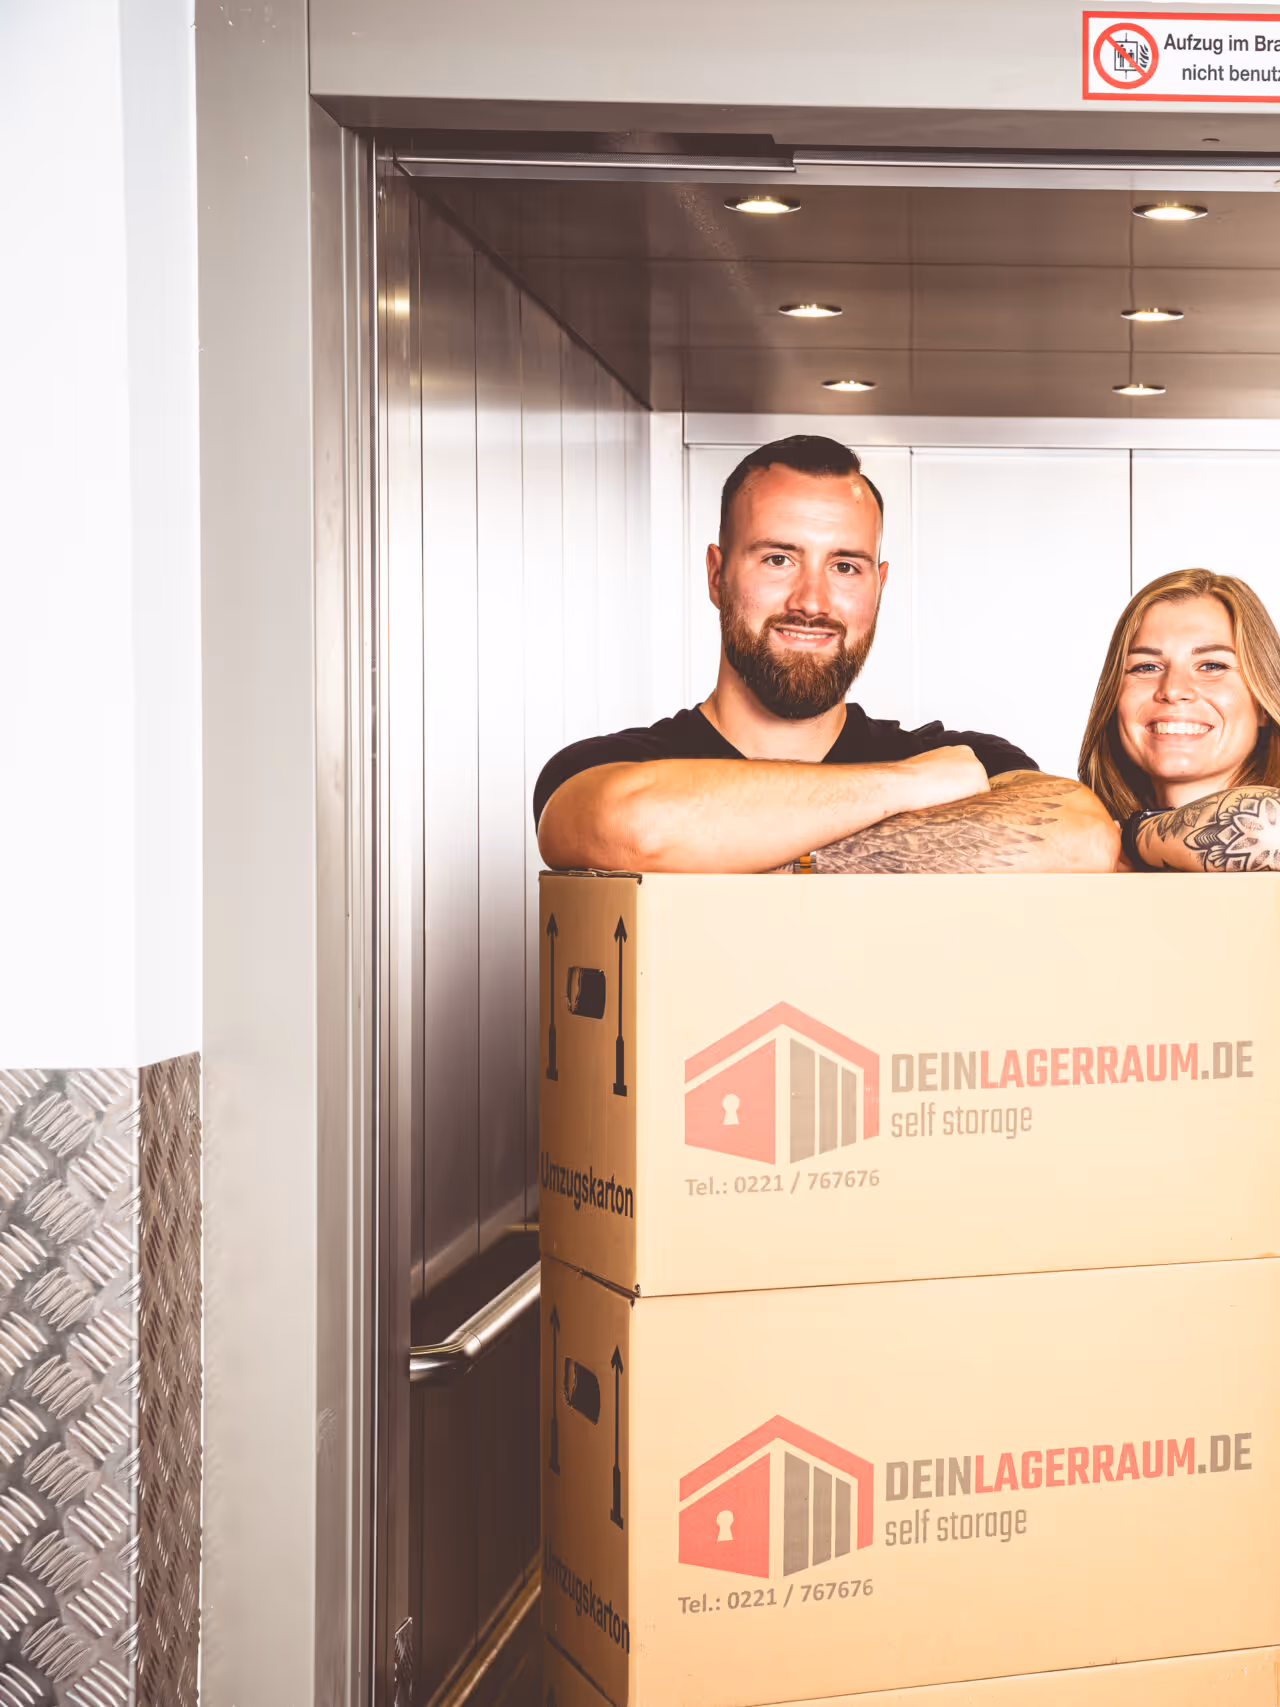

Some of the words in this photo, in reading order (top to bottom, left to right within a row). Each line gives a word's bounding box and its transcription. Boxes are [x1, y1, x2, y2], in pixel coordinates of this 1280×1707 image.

[1164, 33, 1223, 55] Aufzug
[1229, 34, 1249, 52] im
[1182, 64, 1224, 82] nicht
[891, 1041, 1254, 1093] DEINLAGERRAUM.DE
[891, 1103, 936, 1139] self
[943, 1105, 1033, 1141] storage
[541, 1152, 634, 1219] Umzugskarton
[685, 1176, 728, 1197] Tel.:
[734, 1174, 784, 1194] 0221
[790, 1171, 801, 1195] /
[807, 1169, 880, 1191] 767676
[885, 1432, 1253, 1502] DEINLAGERRAUM.DE
[885, 1509, 930, 1547] self
[937, 1508, 1027, 1544] storage
[543, 1539, 630, 1655] Umzugskarton
[678, 1592, 721, 1615] Tel.:
[728, 1587, 778, 1610] 0221
[783, 1583, 794, 1610] /
[800, 1578, 874, 1603] 767676
